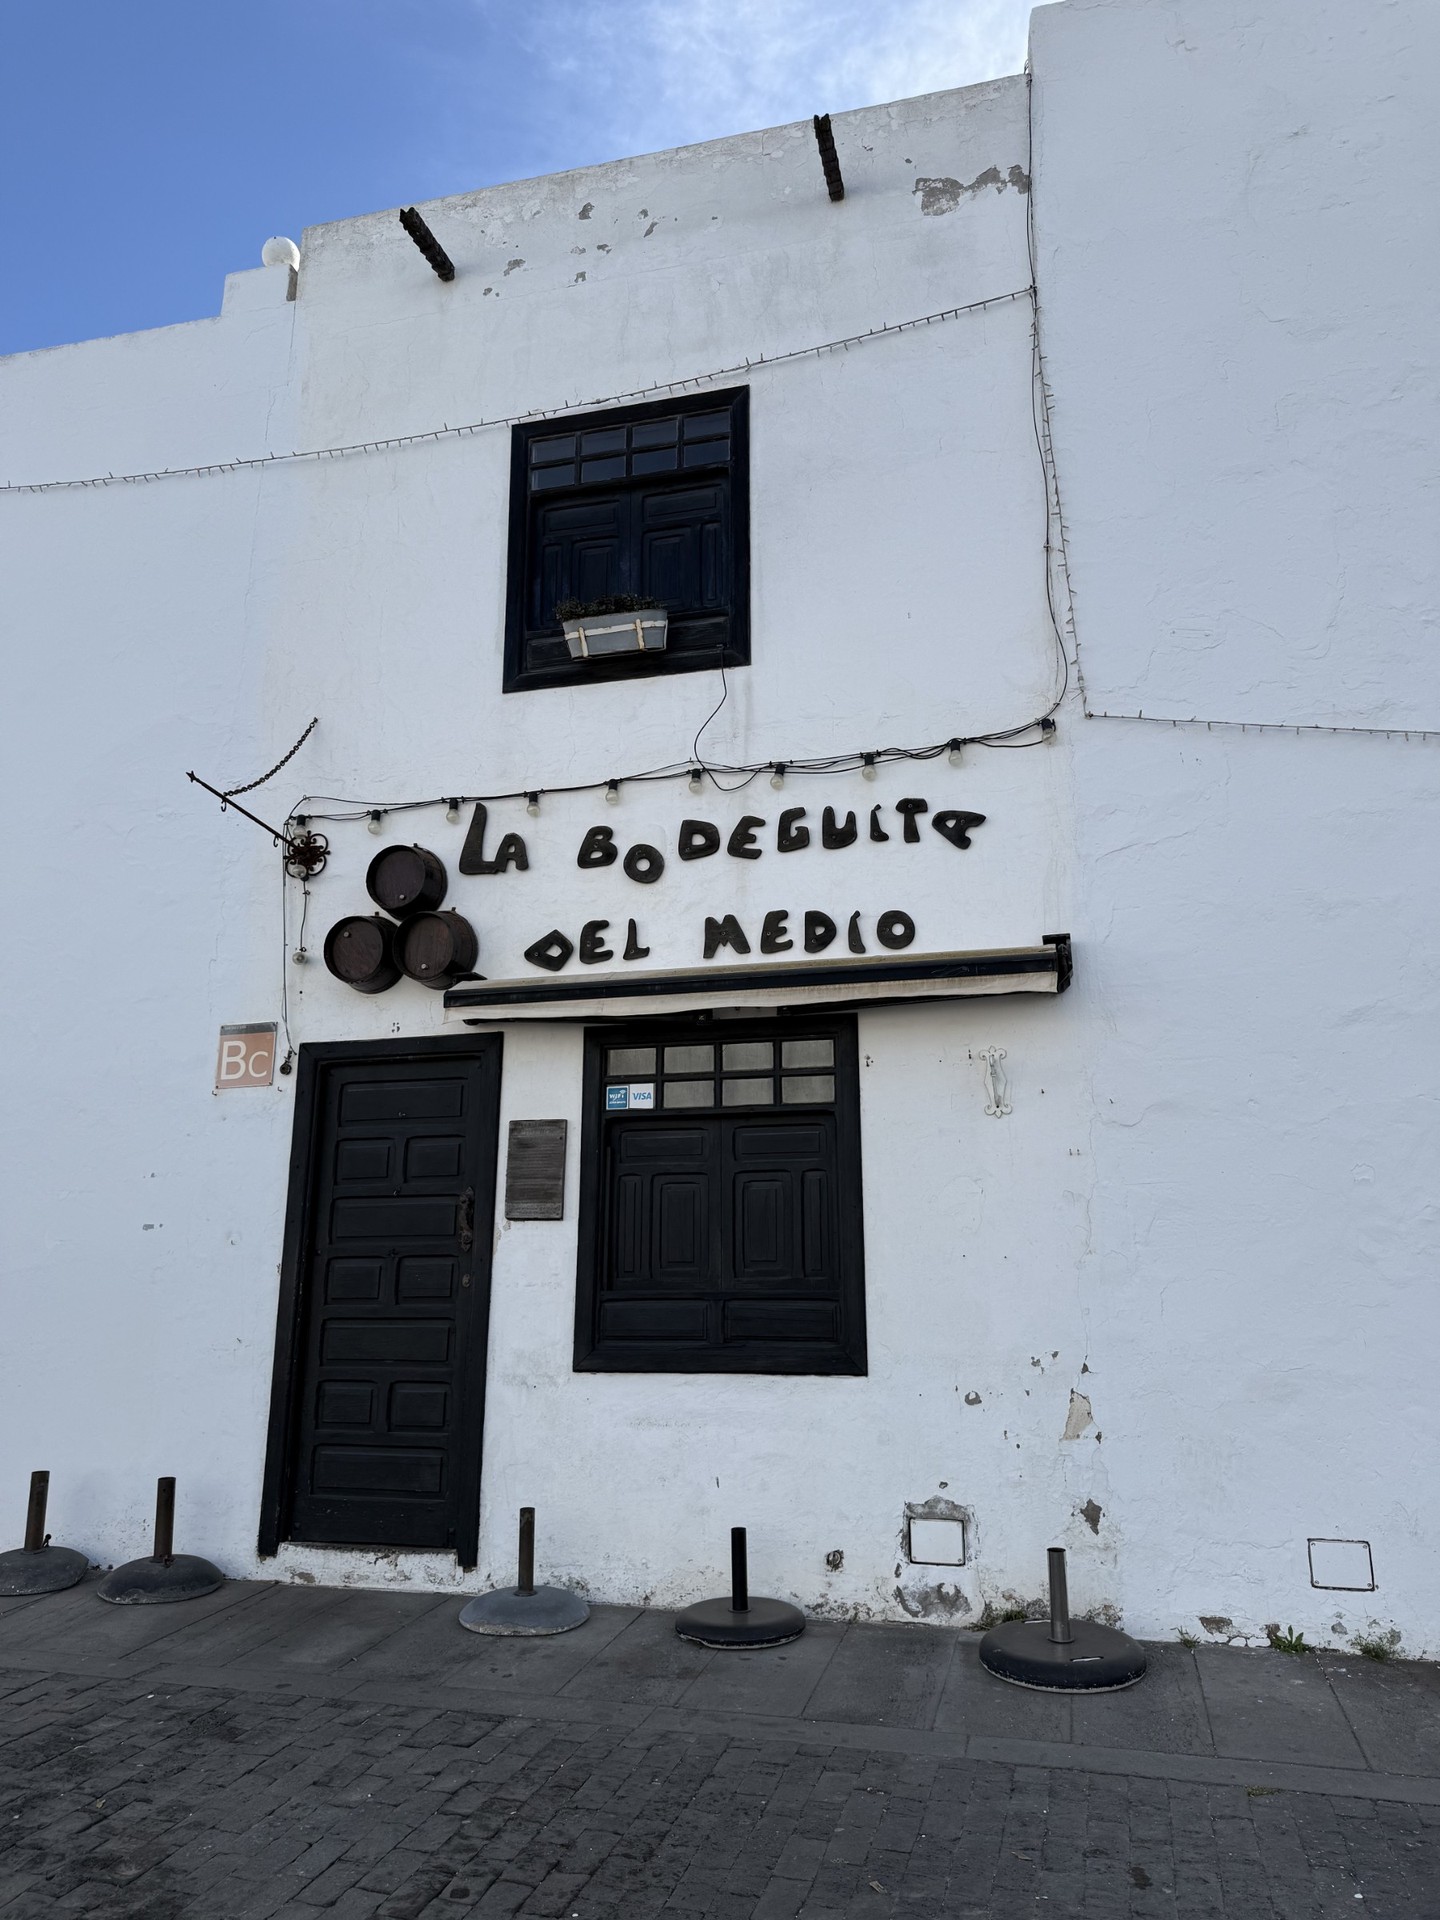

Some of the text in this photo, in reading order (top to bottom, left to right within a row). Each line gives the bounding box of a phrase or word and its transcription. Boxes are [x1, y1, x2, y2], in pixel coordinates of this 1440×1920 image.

[459, 798, 986, 884] LA BODEGUITA
[524, 910, 916, 970] DEL MEDIO
[632, 1091, 652, 1100] VISA
